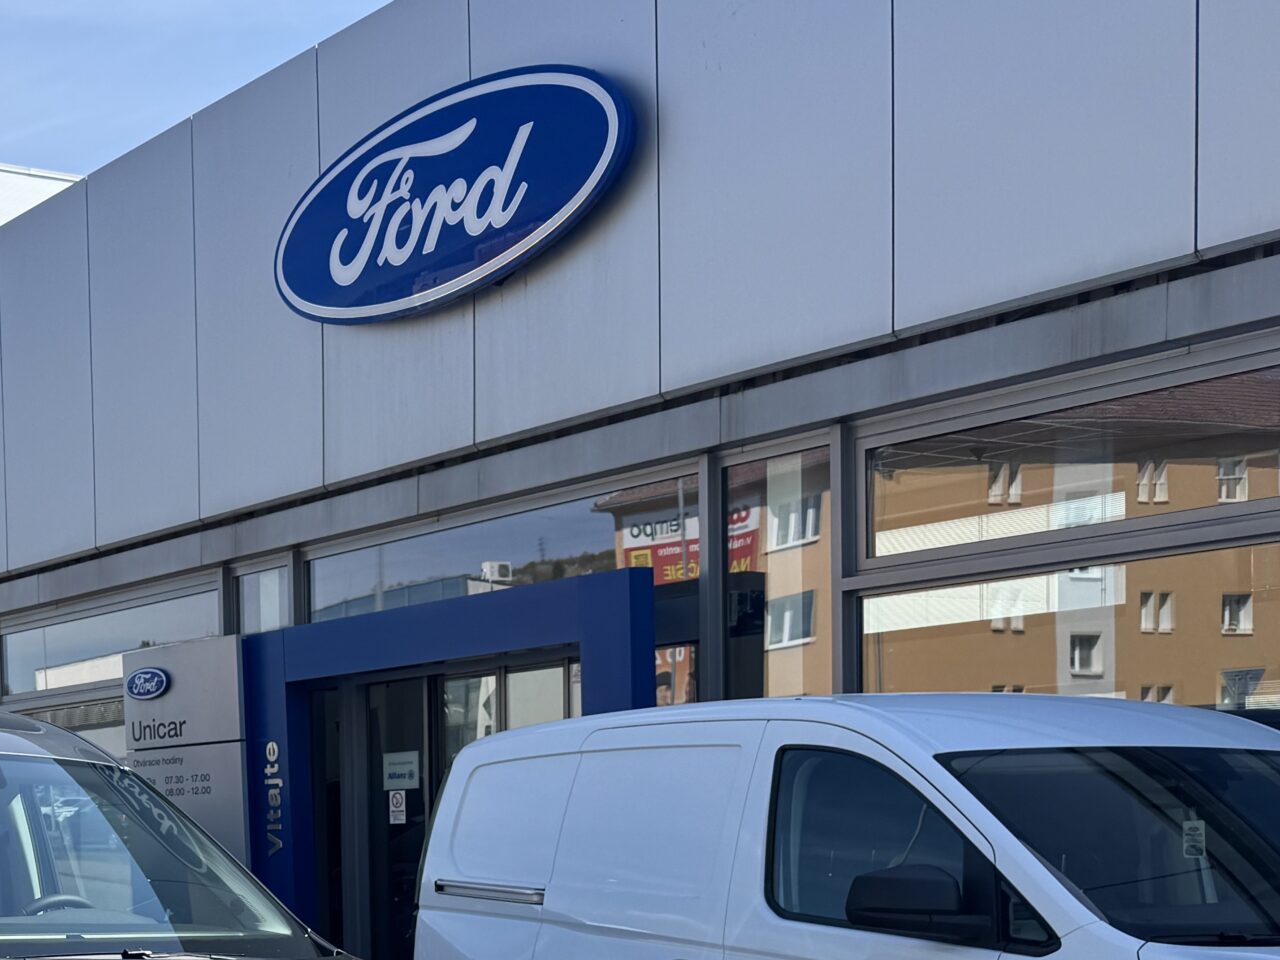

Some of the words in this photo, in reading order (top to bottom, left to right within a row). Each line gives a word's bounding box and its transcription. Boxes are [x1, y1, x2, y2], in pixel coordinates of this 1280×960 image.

[329, 117, 533, 287] Ford
[132, 673, 159, 694] Ford
[131, 718, 187, 742] Unicar
[164, 776, 184, 785] 07.30
[191, 773, 211, 783] 17.00
[191, 786, 212, 796] 12.00
